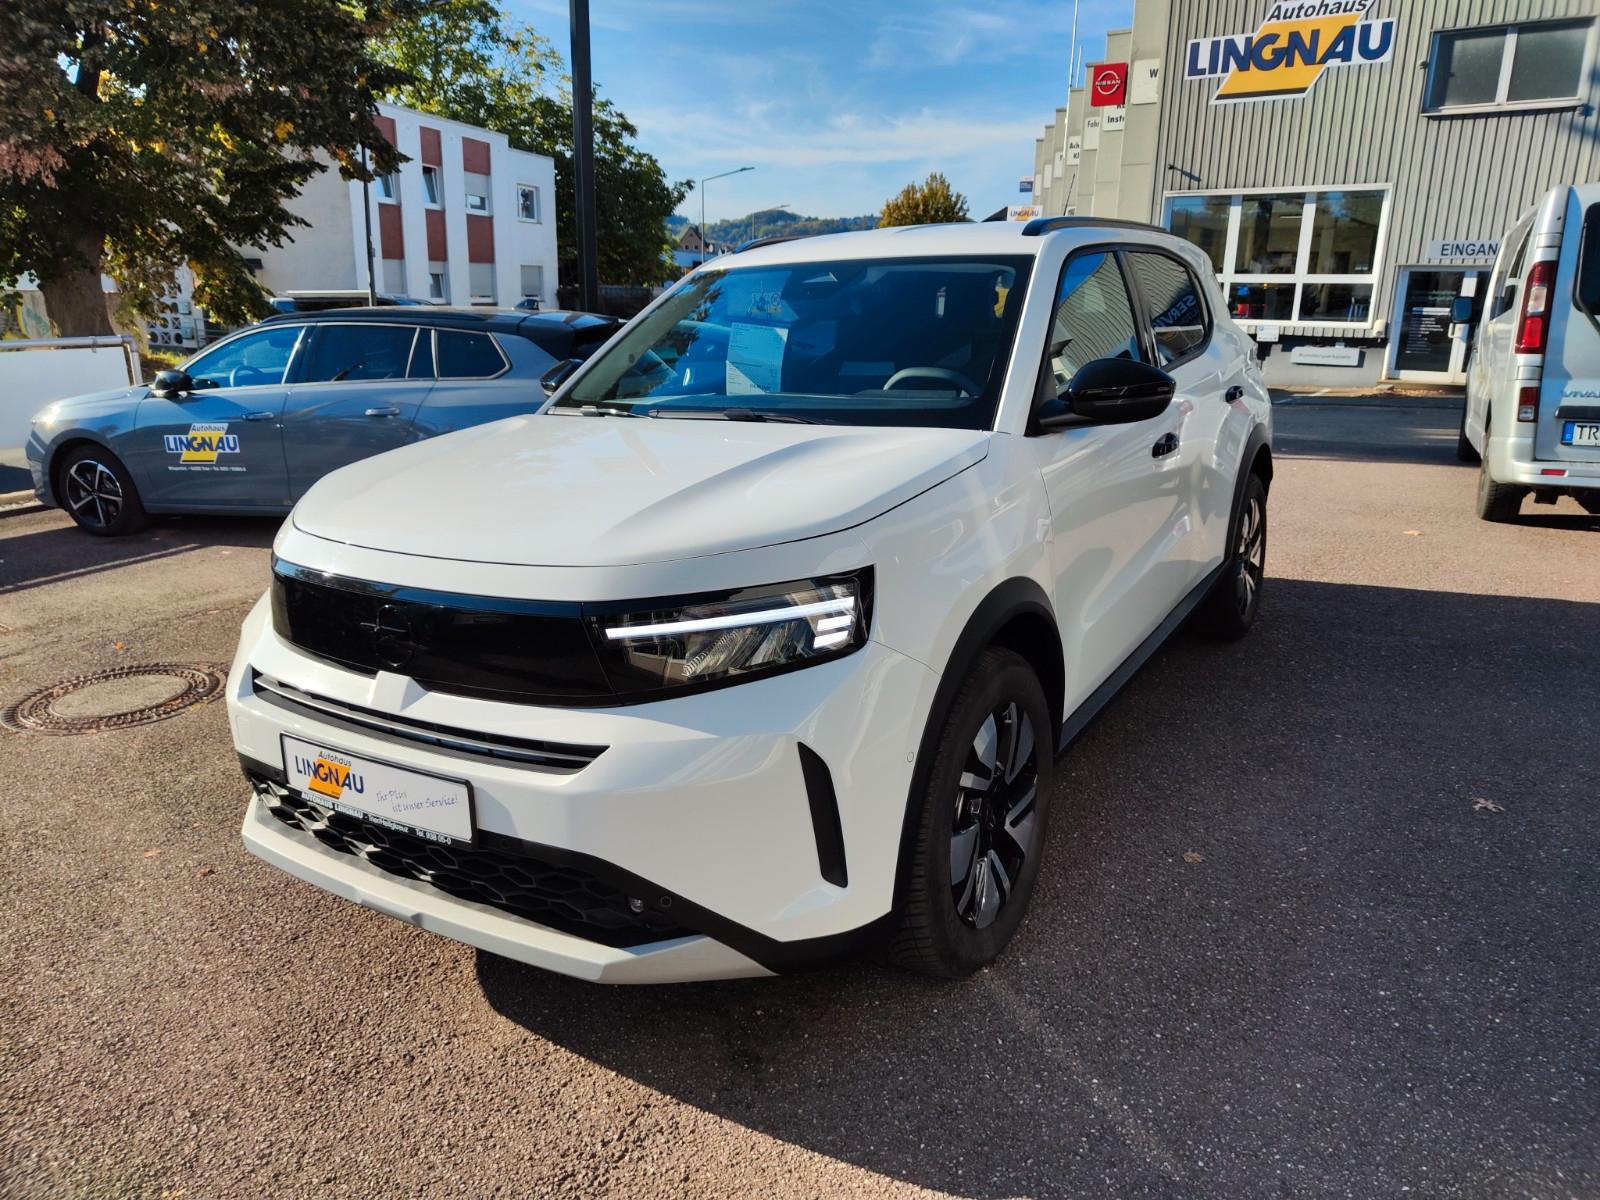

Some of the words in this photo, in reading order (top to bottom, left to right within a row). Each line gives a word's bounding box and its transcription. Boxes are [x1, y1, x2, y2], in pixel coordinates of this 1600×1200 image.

[1267, 0, 1368, 22] Autohaus
[1187, 21, 1394, 77] LINGNAU
[1095, 79, 1121, 87] NISSAN
[191, 424, 225, 432] Autohaus
[165, 436, 238, 452] LINGNAU
[317, 751, 352, 767] Autohaus
[295, 755, 365, 794] LINGNAU
